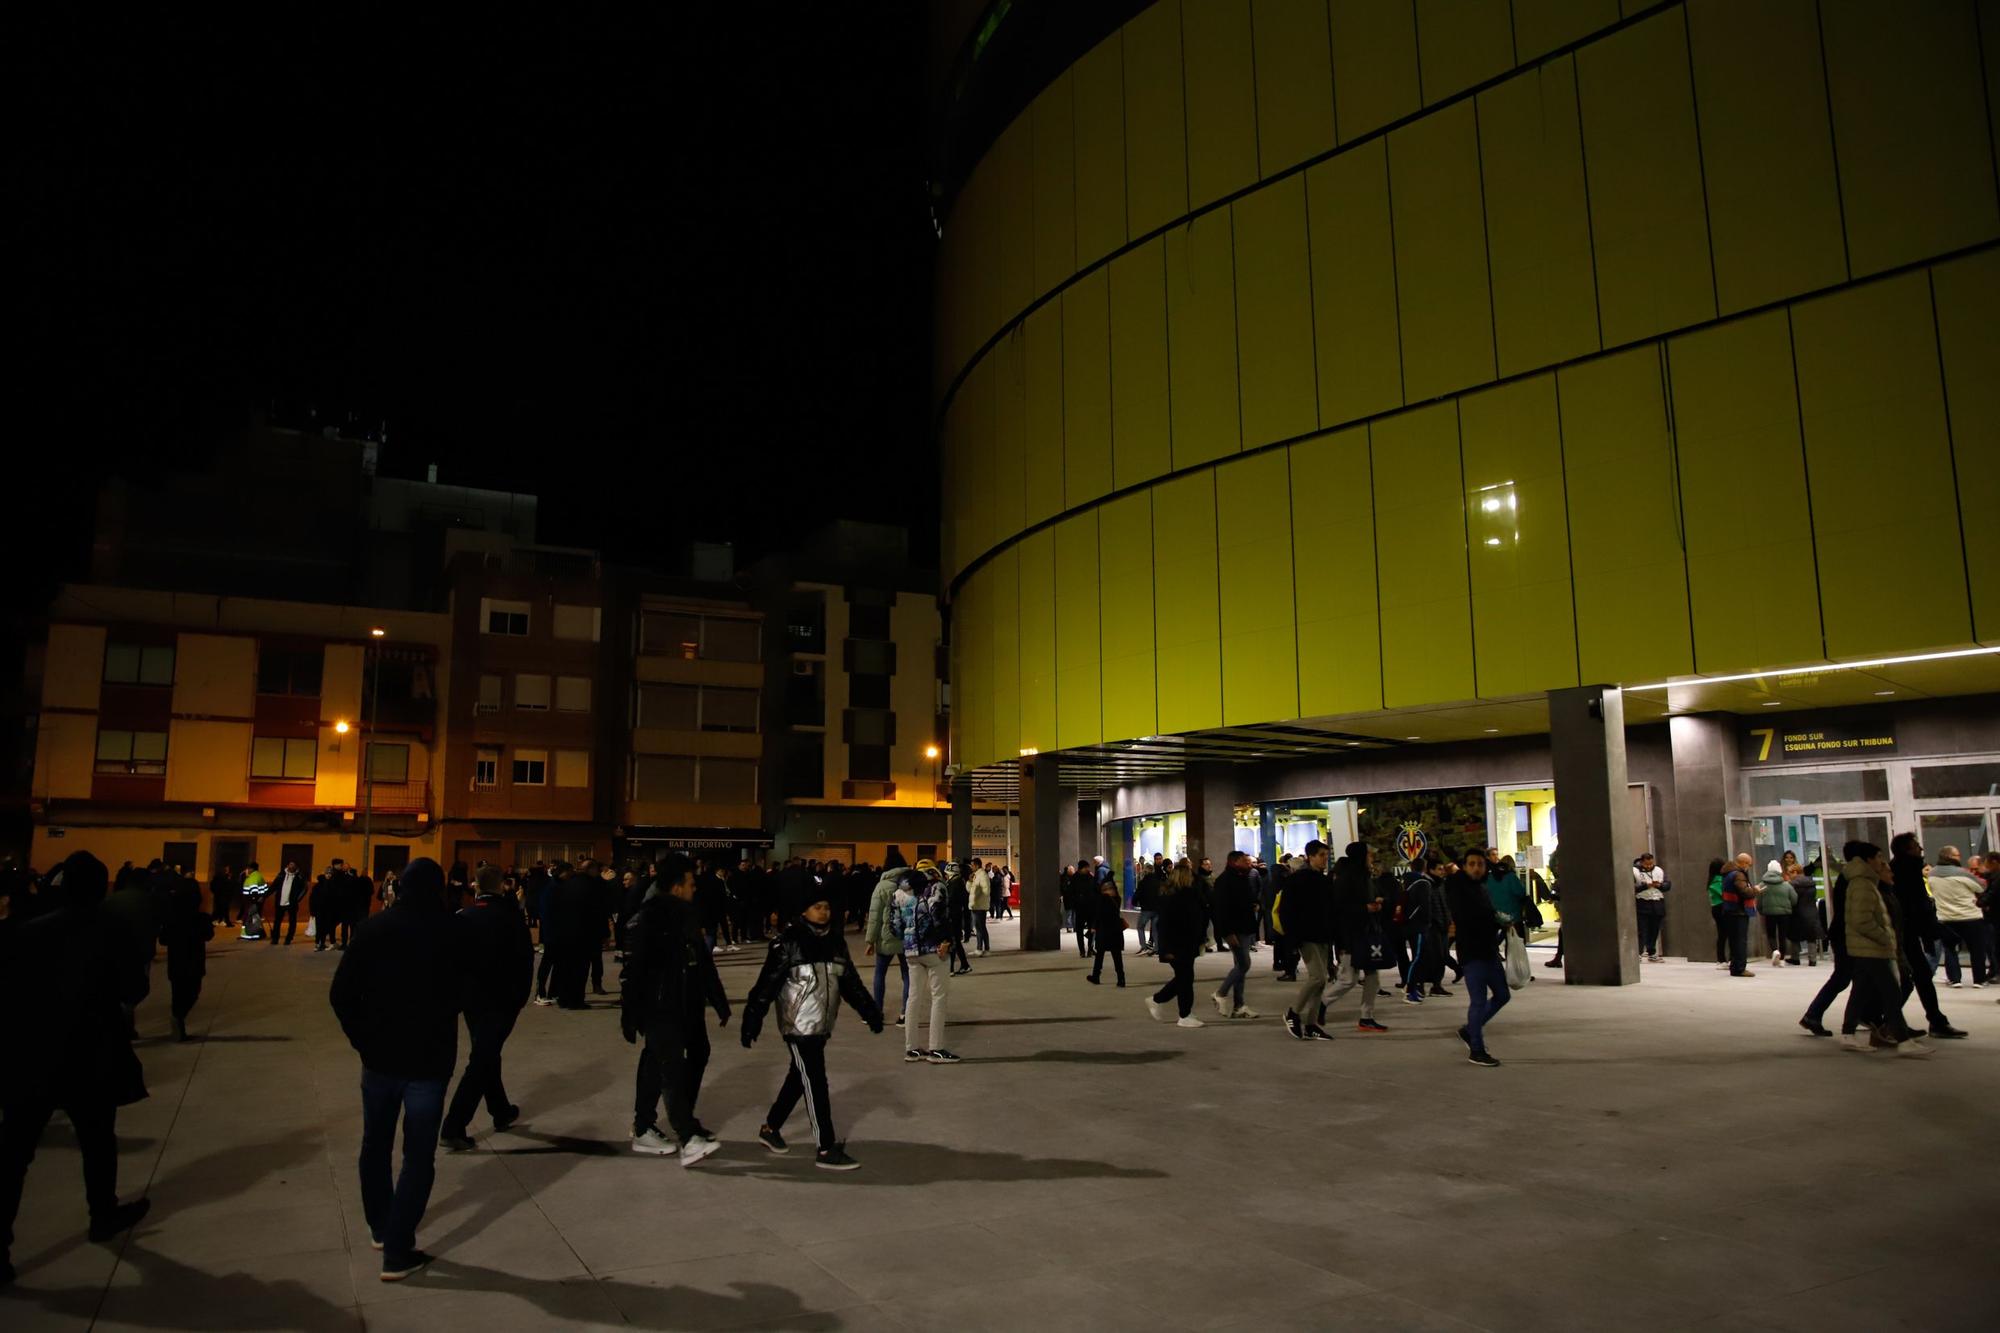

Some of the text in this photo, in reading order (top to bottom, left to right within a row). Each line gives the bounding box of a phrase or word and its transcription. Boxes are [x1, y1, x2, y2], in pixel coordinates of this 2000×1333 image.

[1784, 732, 1824, 742] FONDO SUR
[1750, 727, 1775, 761] 7
[1785, 737, 1893, 751] ESQUINA FONDO SUR TRIBUNA
[669, 840, 732, 849] BAR DEPORTIVO
